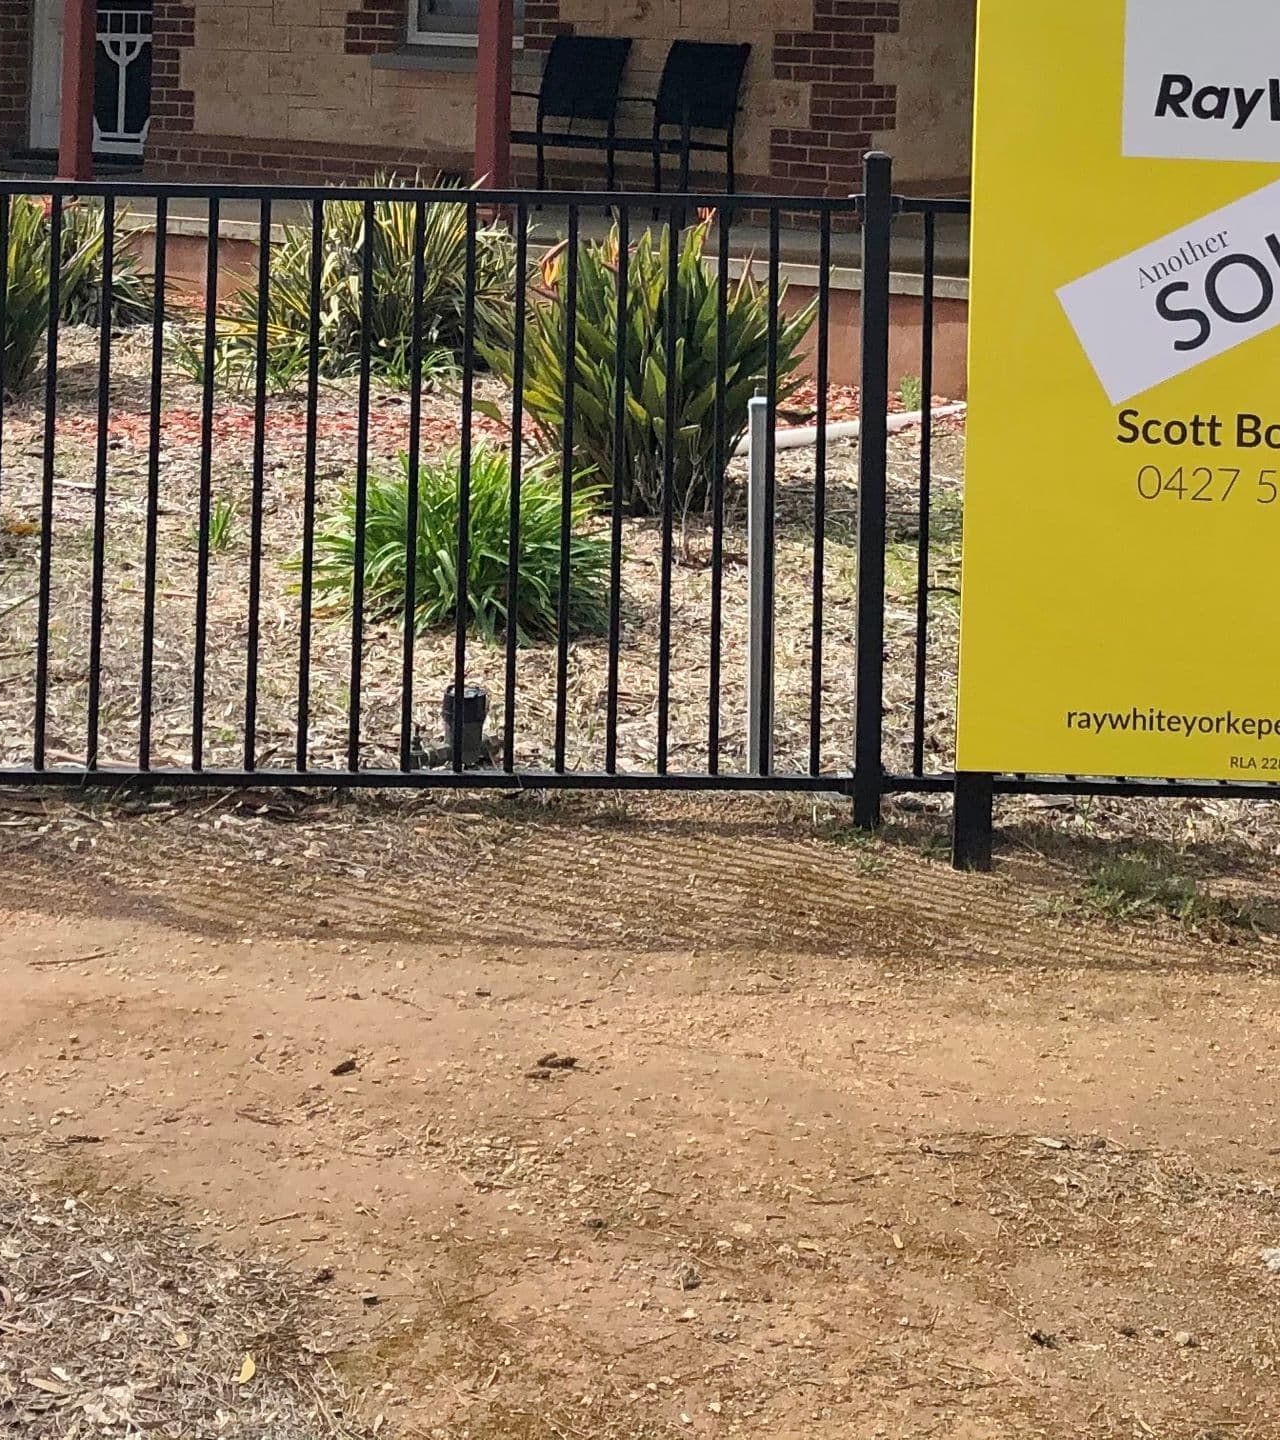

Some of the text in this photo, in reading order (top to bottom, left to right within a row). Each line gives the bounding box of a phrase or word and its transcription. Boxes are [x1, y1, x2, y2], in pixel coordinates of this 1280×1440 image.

[1136, 229, 1229, 289] Another
[1117, 409, 1222, 447] Scott
[1138, 465, 1240, 501] 0427
[1229, 756, 1257, 769] RLA
